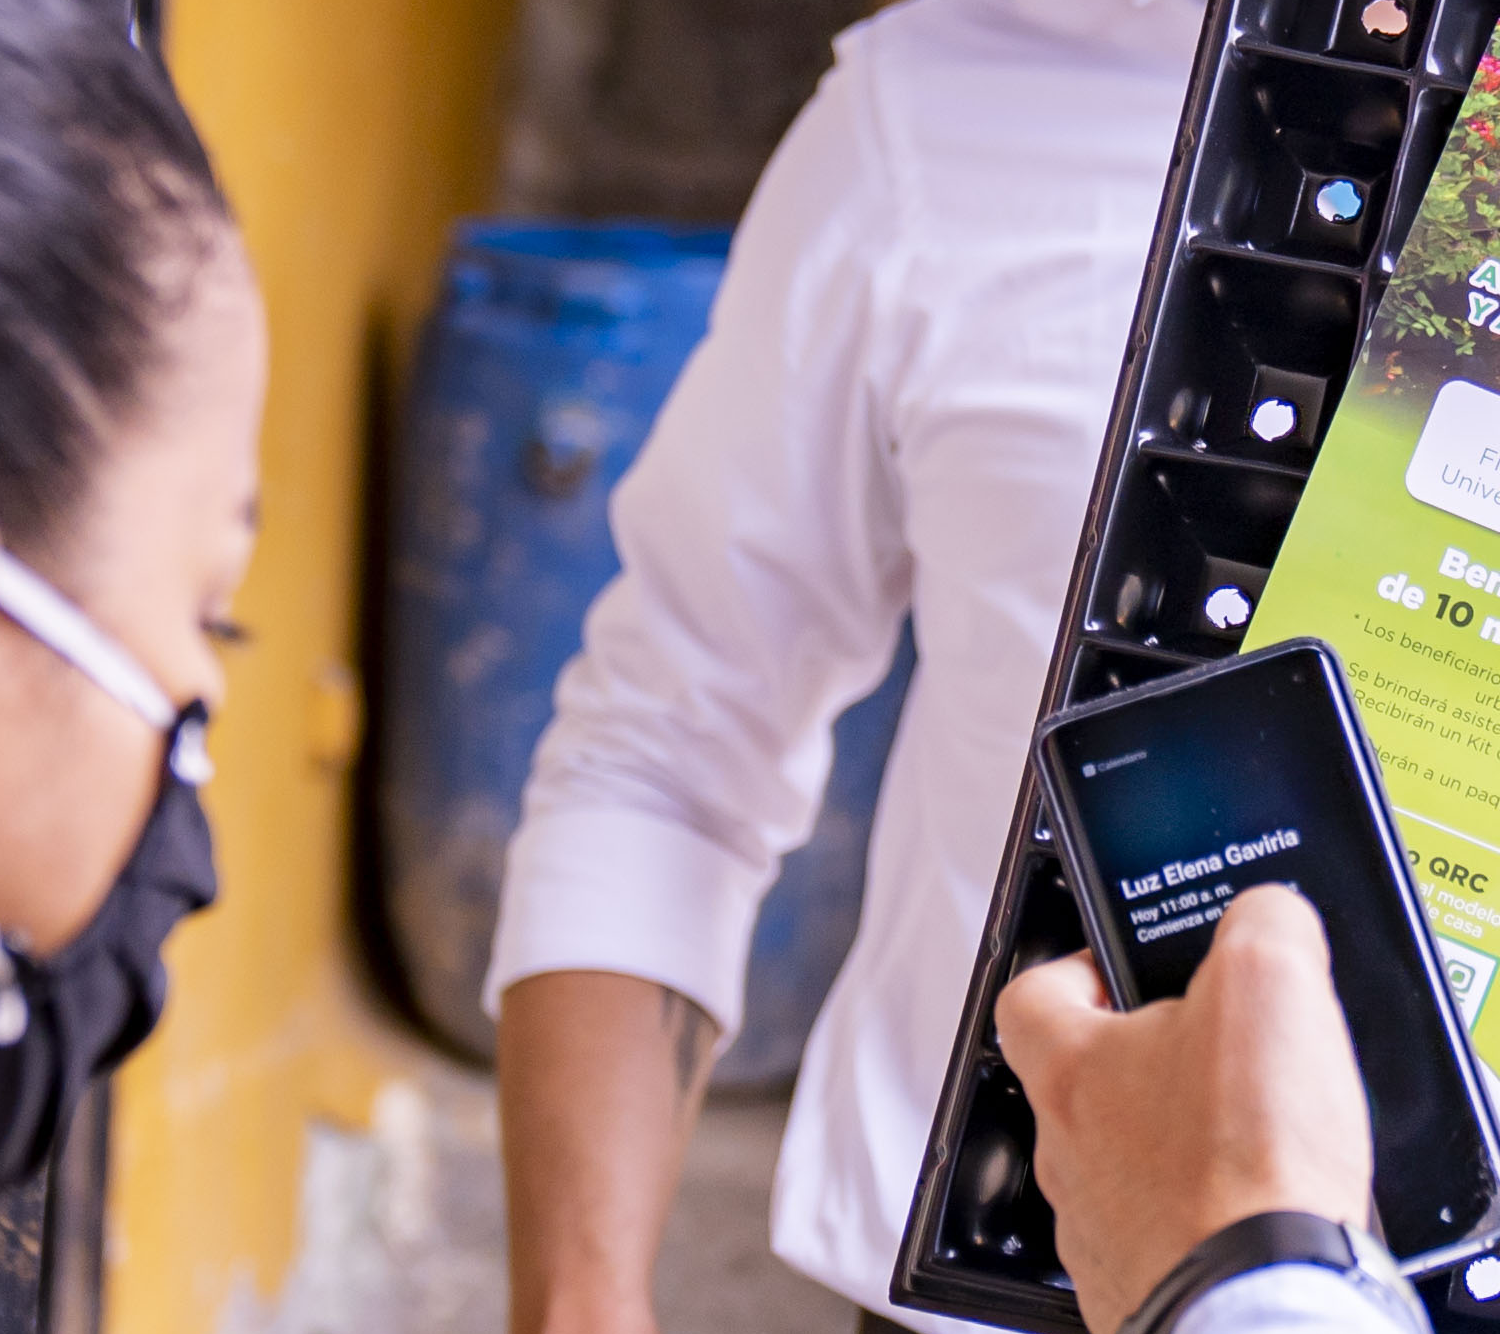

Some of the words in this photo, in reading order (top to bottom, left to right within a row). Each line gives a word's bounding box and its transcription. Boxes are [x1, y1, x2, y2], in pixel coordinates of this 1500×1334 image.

[1472, 296, 1493, 323] Y
[1377, 572, 1425, 610] de
[1436, 594, 1473, 627] 10
[1363, 618, 1395, 642] Los
[1346, 662, 1368, 682] Se
[1373, 671, 1447, 713] brindará
[1352, 689, 1434, 732] Recibirán
[1439, 725, 1461, 743] un
[1466, 733, 1492, 755] Kit
[1423, 768, 1434, 781] a
[1439, 774, 1461, 791] un
[1120, 873, 1162, 900] Luz
[1162, 854, 1223, 887] Elena
[1225, 829, 1299, 866] Gaviria
[1429, 857, 1488, 893] QRC
[1130, 908, 1160, 926] Hoy
[1160, 893, 1198, 916] 11:00
[1200, 890, 1214, 903] a.
[1137, 913, 1204, 943] Comienza
[1205, 908, 1222, 921] en
[1443, 913, 1483, 938] casa
